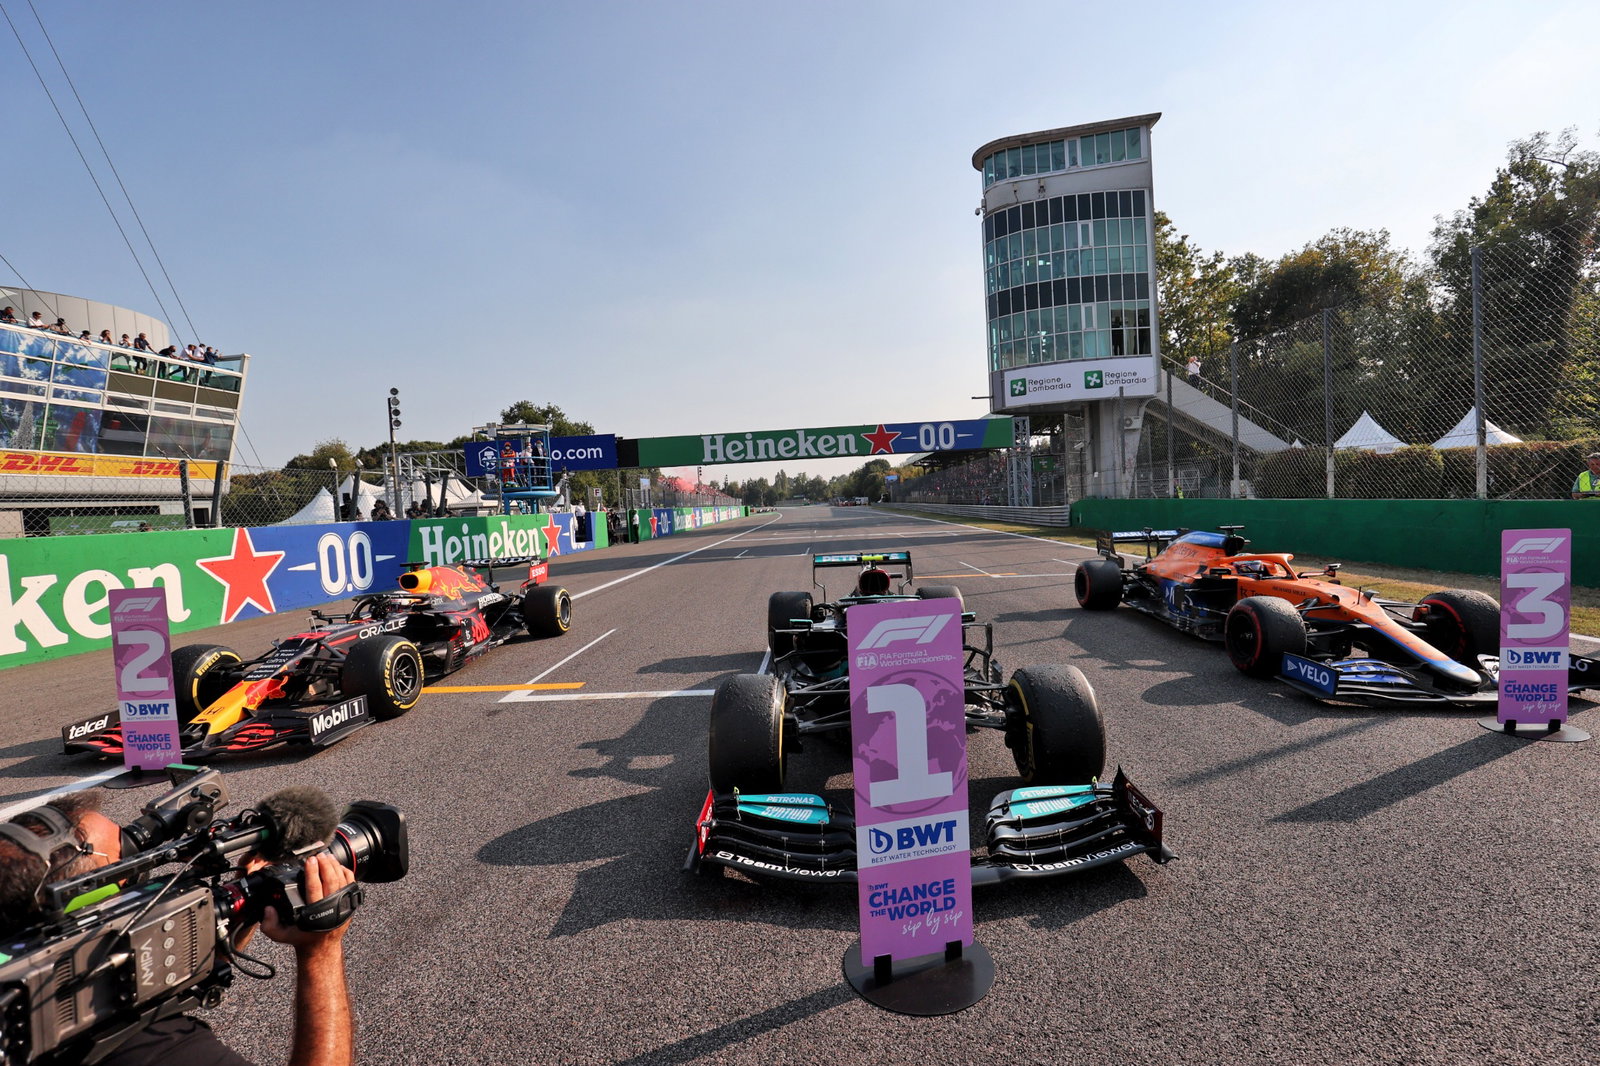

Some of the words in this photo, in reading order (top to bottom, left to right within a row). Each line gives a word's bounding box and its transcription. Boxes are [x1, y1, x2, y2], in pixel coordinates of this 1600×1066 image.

[1028, 377, 1061, 386] Regione
[1105, 371, 1137, 379] Regione
[1105, 377, 1147, 385] Lombardia
[1028, 383, 1072, 393] Lombardia
[918, 421, 956, 450] 0.0
[701, 430, 859, 463] Heineken
[0, 454, 82, 472] DHL
[131, 461, 188, 476] DHL
[419, 520, 542, 569] Heineken
[317, 531, 374, 597] 0.0
[1506, 572, 1565, 639] 3
[359, 616, 409, 640] ORACLE
[117, 630, 169, 693] 2
[856, 653, 879, 670] FIA
[879, 658, 902, 668] World
[902, 654, 953, 666] Championship
[892, 651, 924, 659] Formula
[1523, 651, 1562, 664] BWT
[1298, 662, 1329, 686] VELO
[1503, 684, 1558, 693] CHANGE
[1514, 693, 1558, 702] WORLD
[139, 703, 170, 716] BWT
[68, 715, 109, 740] telcel
[312, 704, 349, 736] Mobil
[126, 733, 171, 743] CHANGE
[136, 743, 172, 751] WORLD
[866, 683, 955, 808] 1
[766, 796, 815, 804] PETRONAS
[1019, 787, 1066, 798] PETRONAS
[896, 820, 957, 850] BWT
[871, 855, 888, 864] BEST
[888, 852, 912, 861] WATER
[912, 844, 957, 857] TECHNOLOGY
[1031, 841, 1138, 872] TeamViewer
[734, 854, 846, 877] TeamViewer
[868, 878, 956, 908] CHANGE
[874, 882, 889, 891] BWT
[309, 908, 334, 921] Canon
[870, 908, 887, 918] THE
[887, 896, 957, 921] WORLD
[901, 920, 922, 938] sip
[926, 907, 940, 935] by
[943, 910, 963, 927] sip
